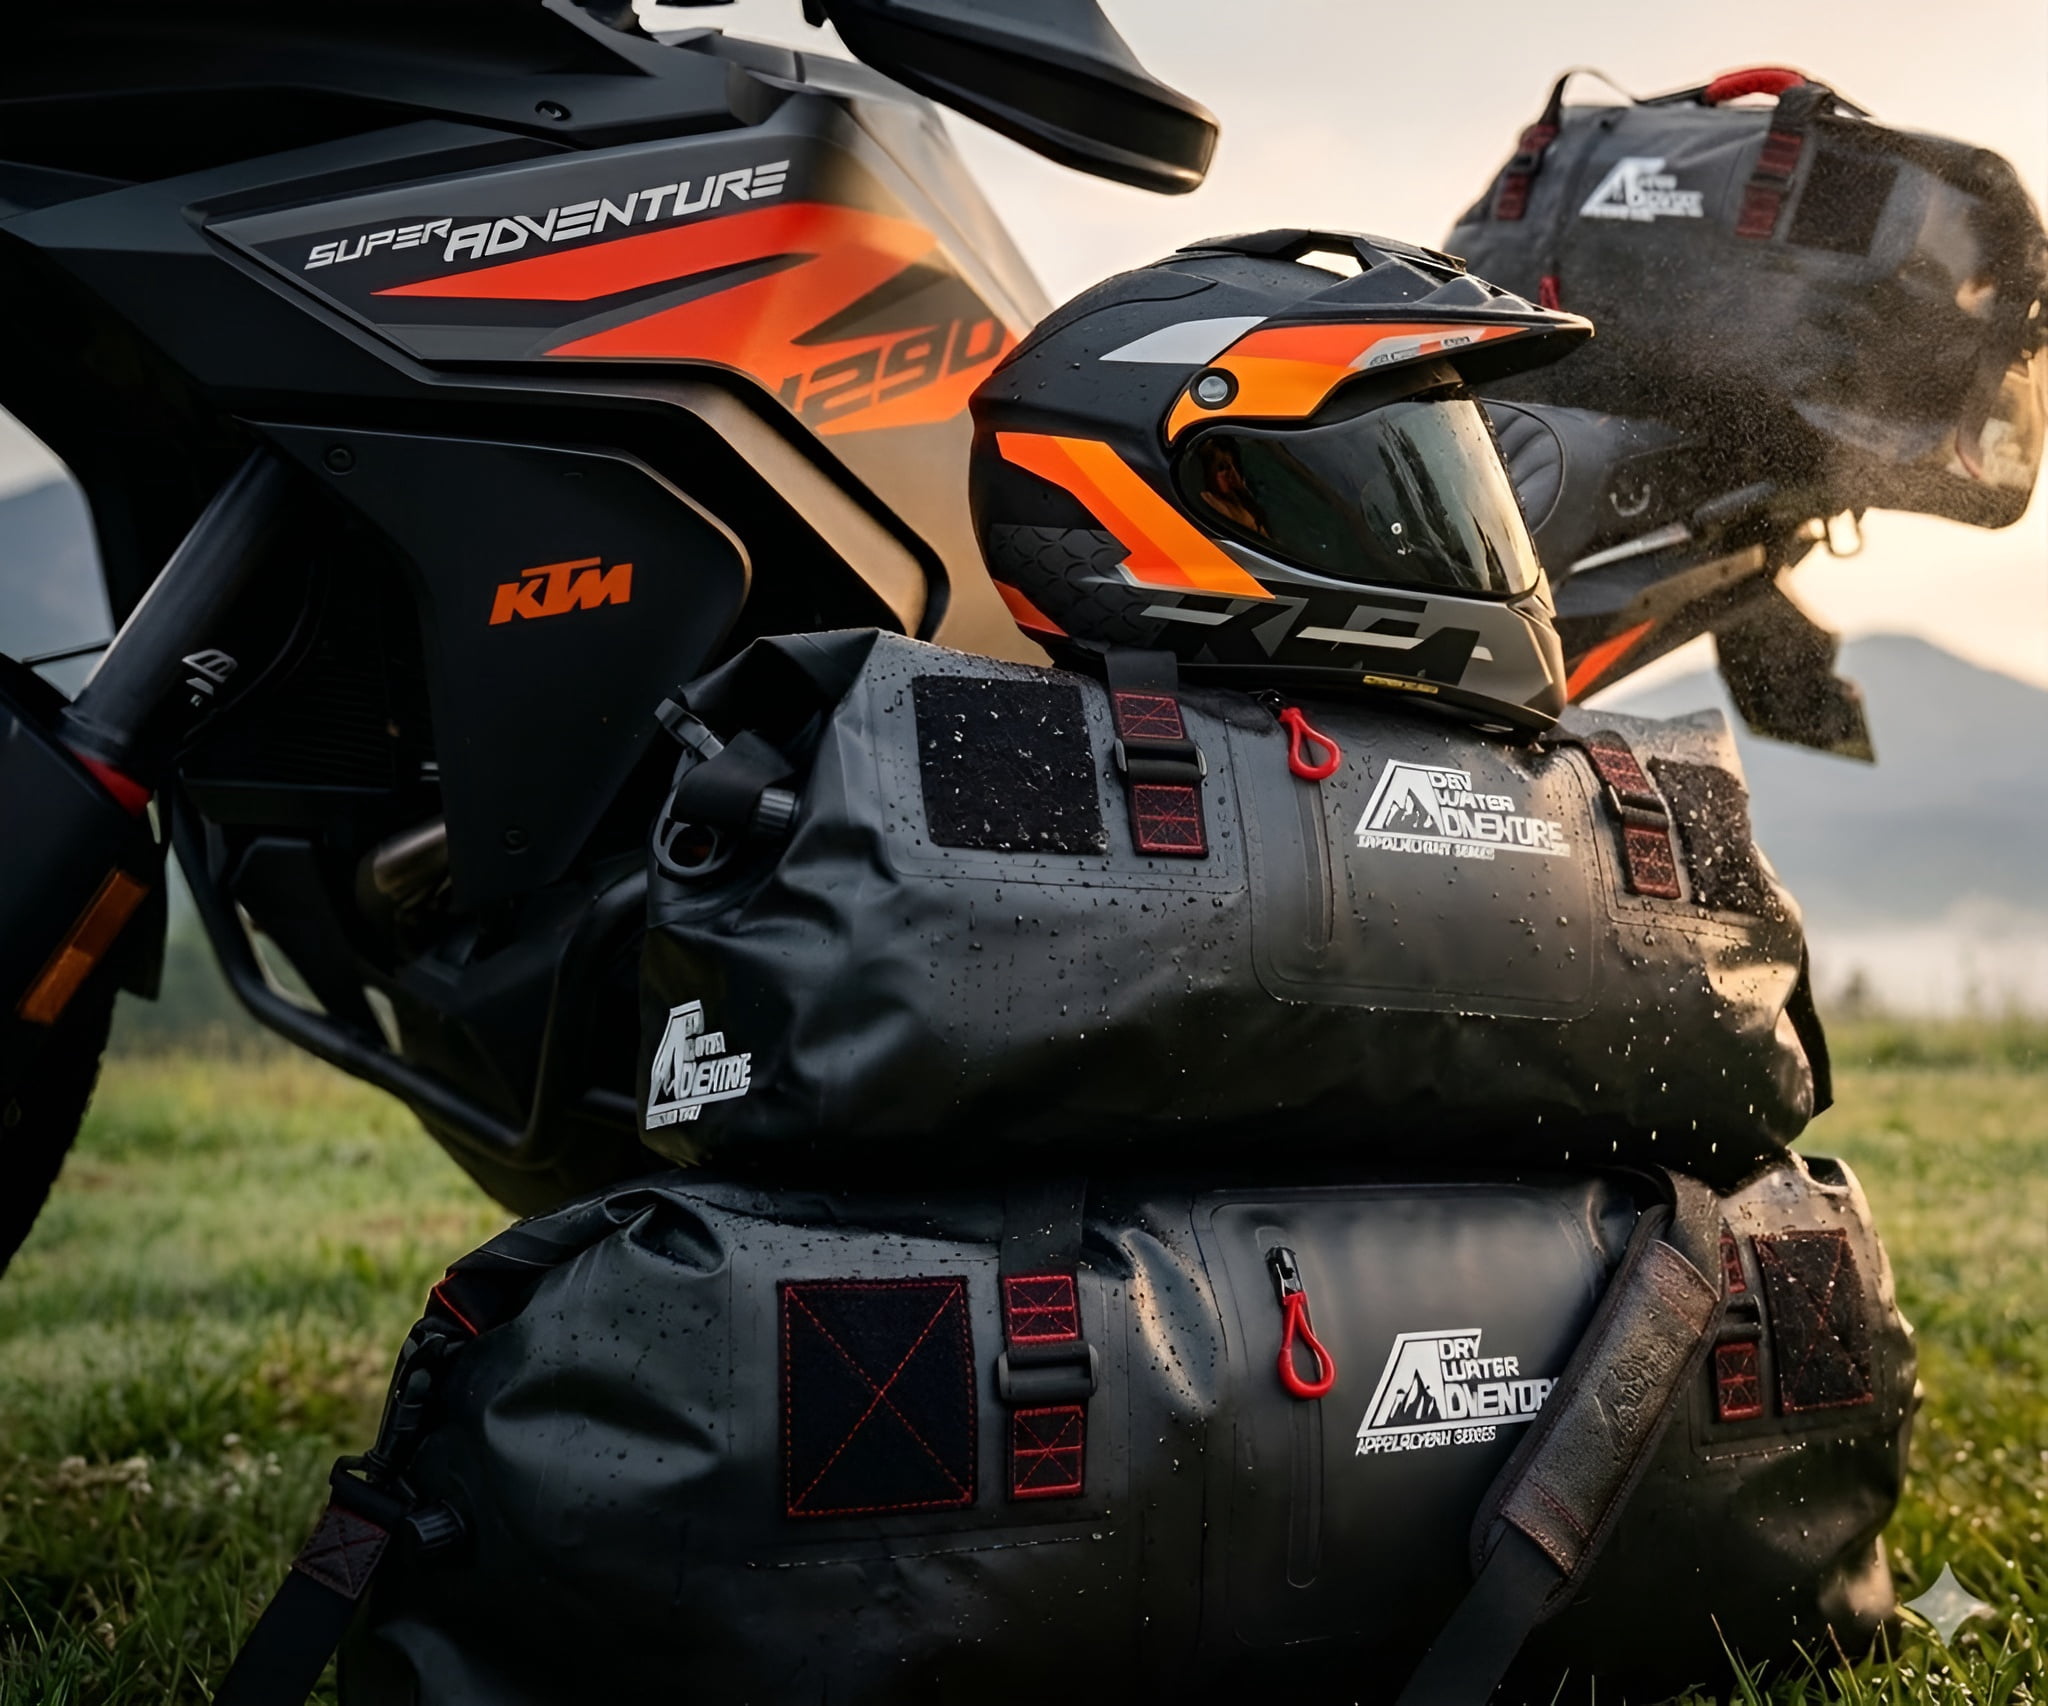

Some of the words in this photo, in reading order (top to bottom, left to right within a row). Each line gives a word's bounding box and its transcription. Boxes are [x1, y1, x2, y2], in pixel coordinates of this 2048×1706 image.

[304, 217, 453, 270] SUPER
[443, 160, 790, 262] ADVENTURE
[779, 318, 1007, 429] 1290
[488, 556, 633, 625] KTM
[1438, 1337, 1480, 1360] DRY
